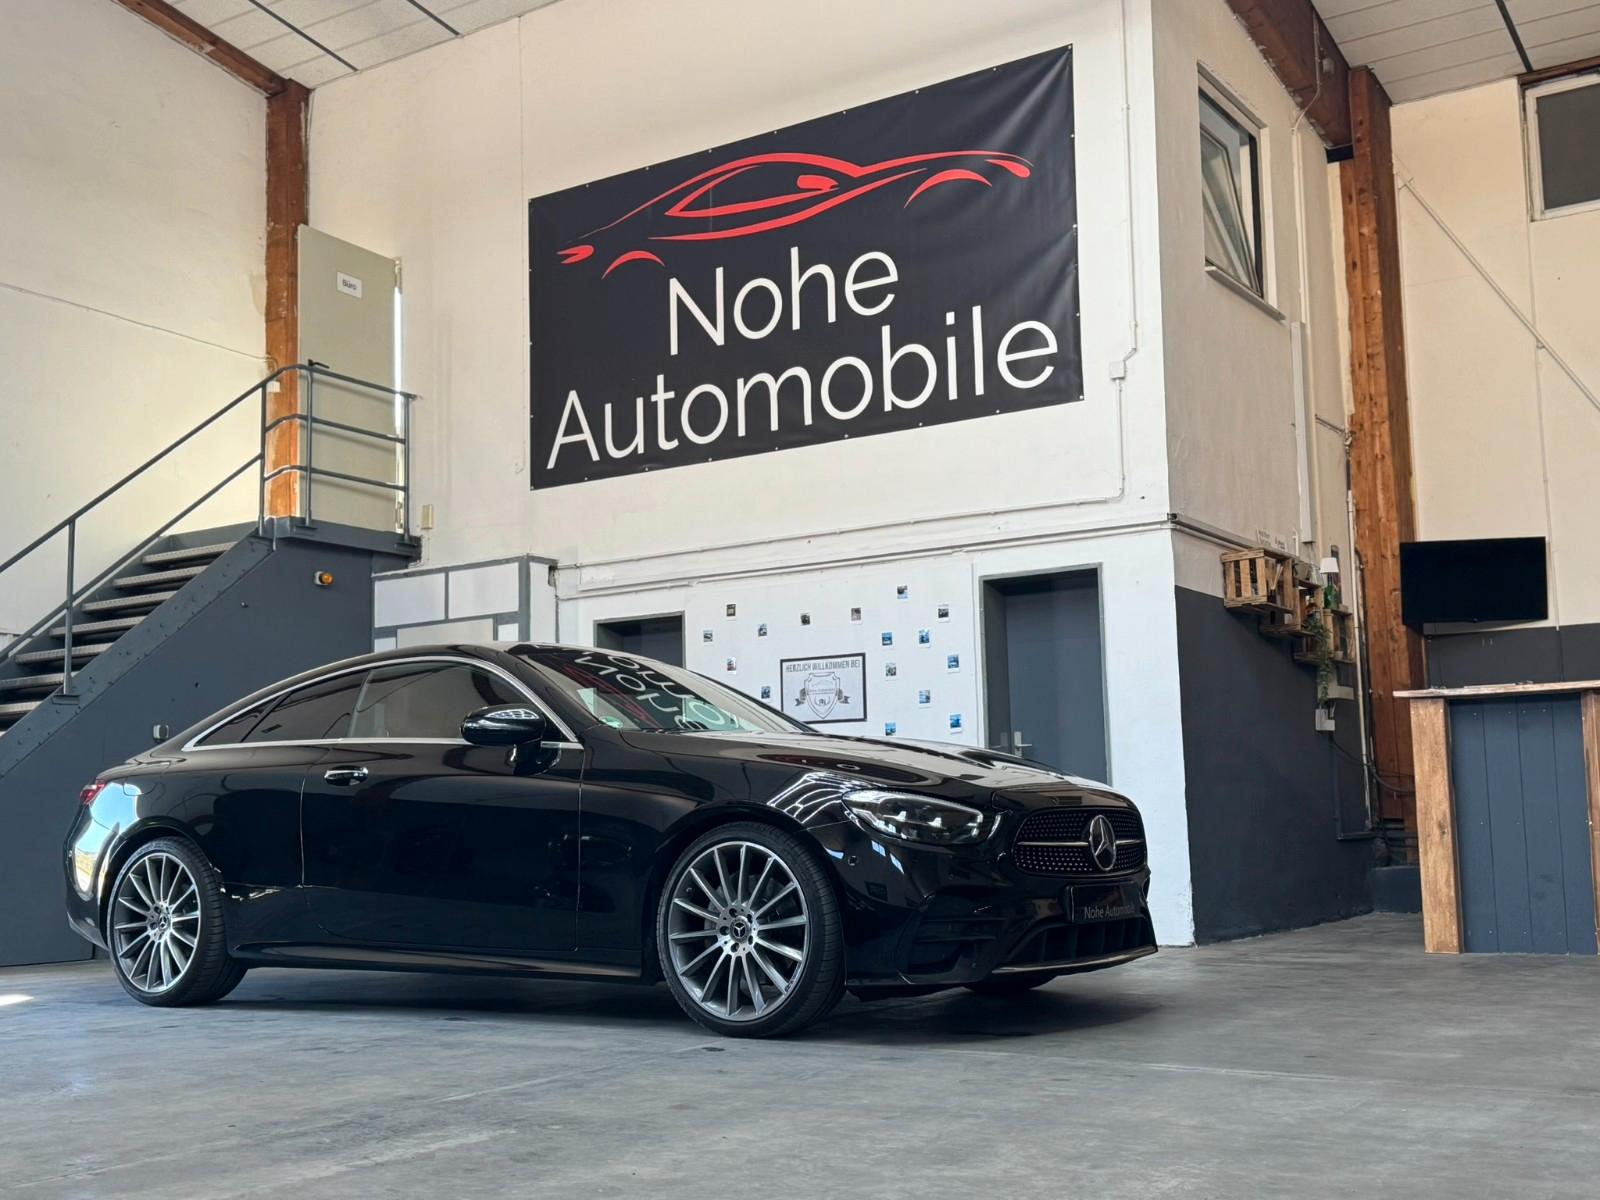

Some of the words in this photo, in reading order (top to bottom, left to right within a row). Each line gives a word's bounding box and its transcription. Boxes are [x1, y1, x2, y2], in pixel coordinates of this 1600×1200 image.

[669, 246, 899, 356] Nohe
[546, 304, 1059, 470] Automobile
[785, 662, 811, 672] HERZLICH
[812, 660, 849, 671] WILLKOMMEN
[850, 659, 861, 668] BEI
[1083, 904, 1104, 919] Nohe
